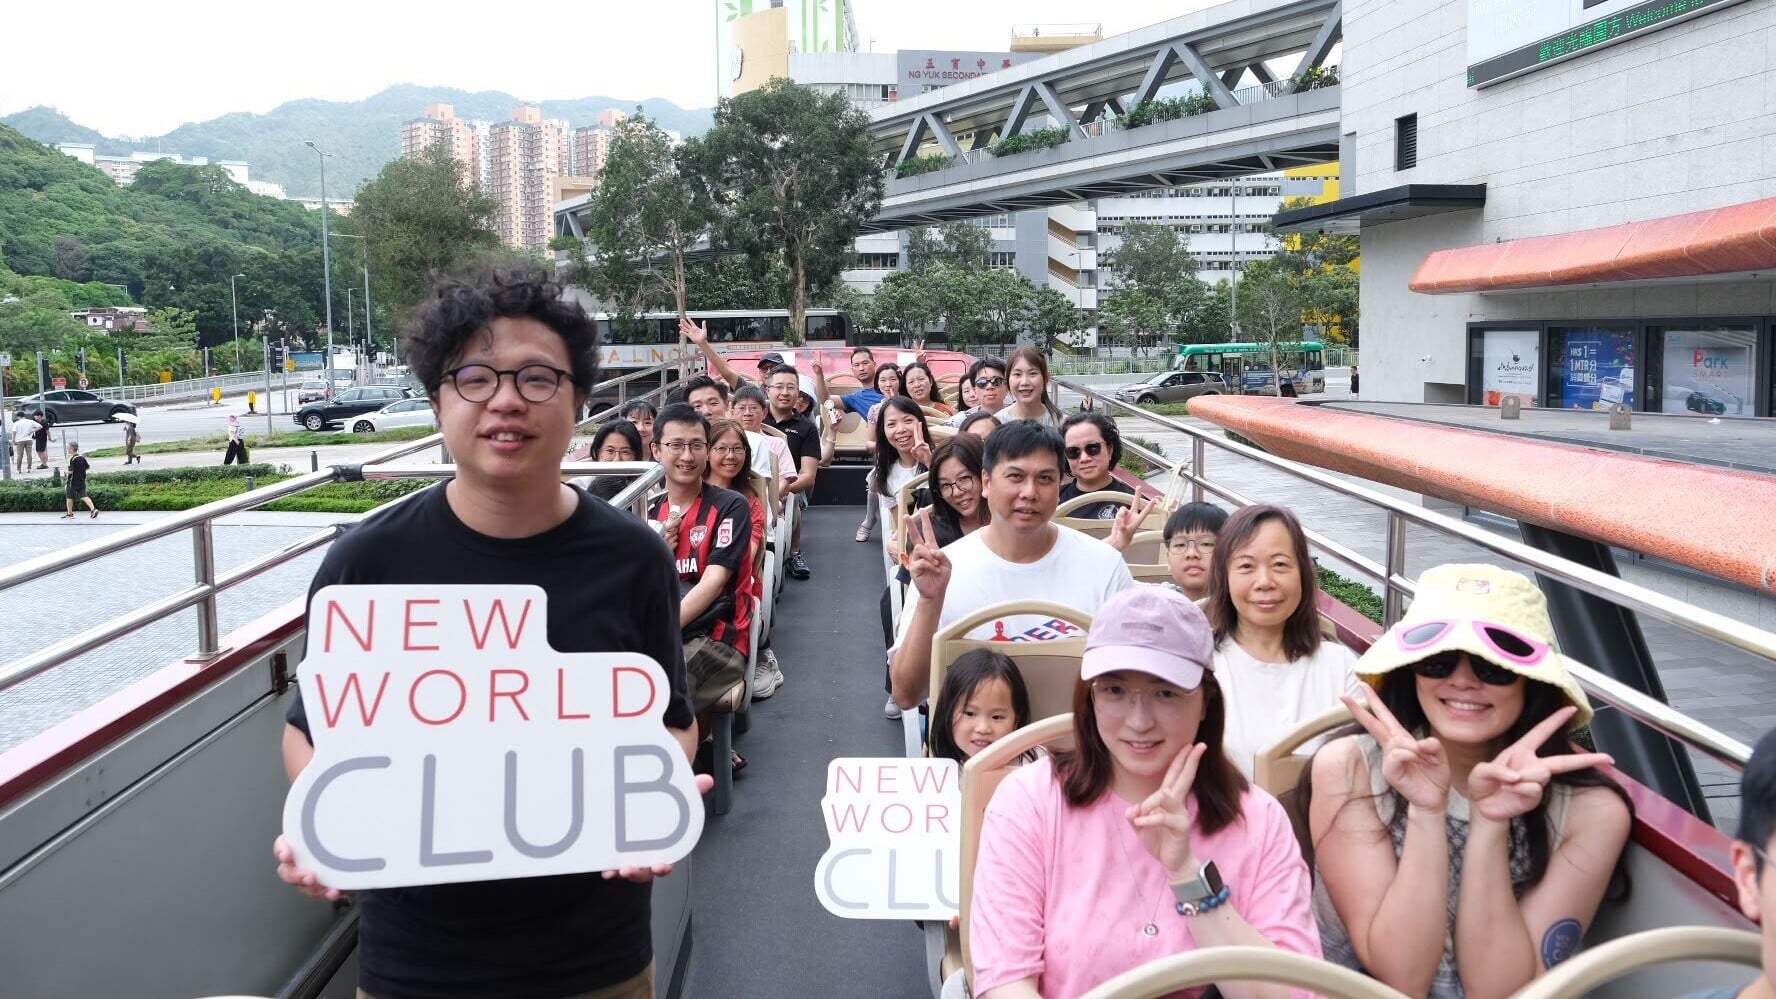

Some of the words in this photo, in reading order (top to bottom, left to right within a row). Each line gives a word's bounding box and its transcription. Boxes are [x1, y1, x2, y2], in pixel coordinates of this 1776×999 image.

[1625, 0, 1687, 28] Welcome
[908, 71, 921, 79] NG
[923, 71, 941, 79] YUK
[1693, 348, 1728, 368] Park
[324, 599, 532, 652] NEW
[315, 667, 657, 728] WORLD
[835, 765, 950, 794] NEW
[300, 744, 691, 872] CLUB
[831, 803, 950, 833] WOR
